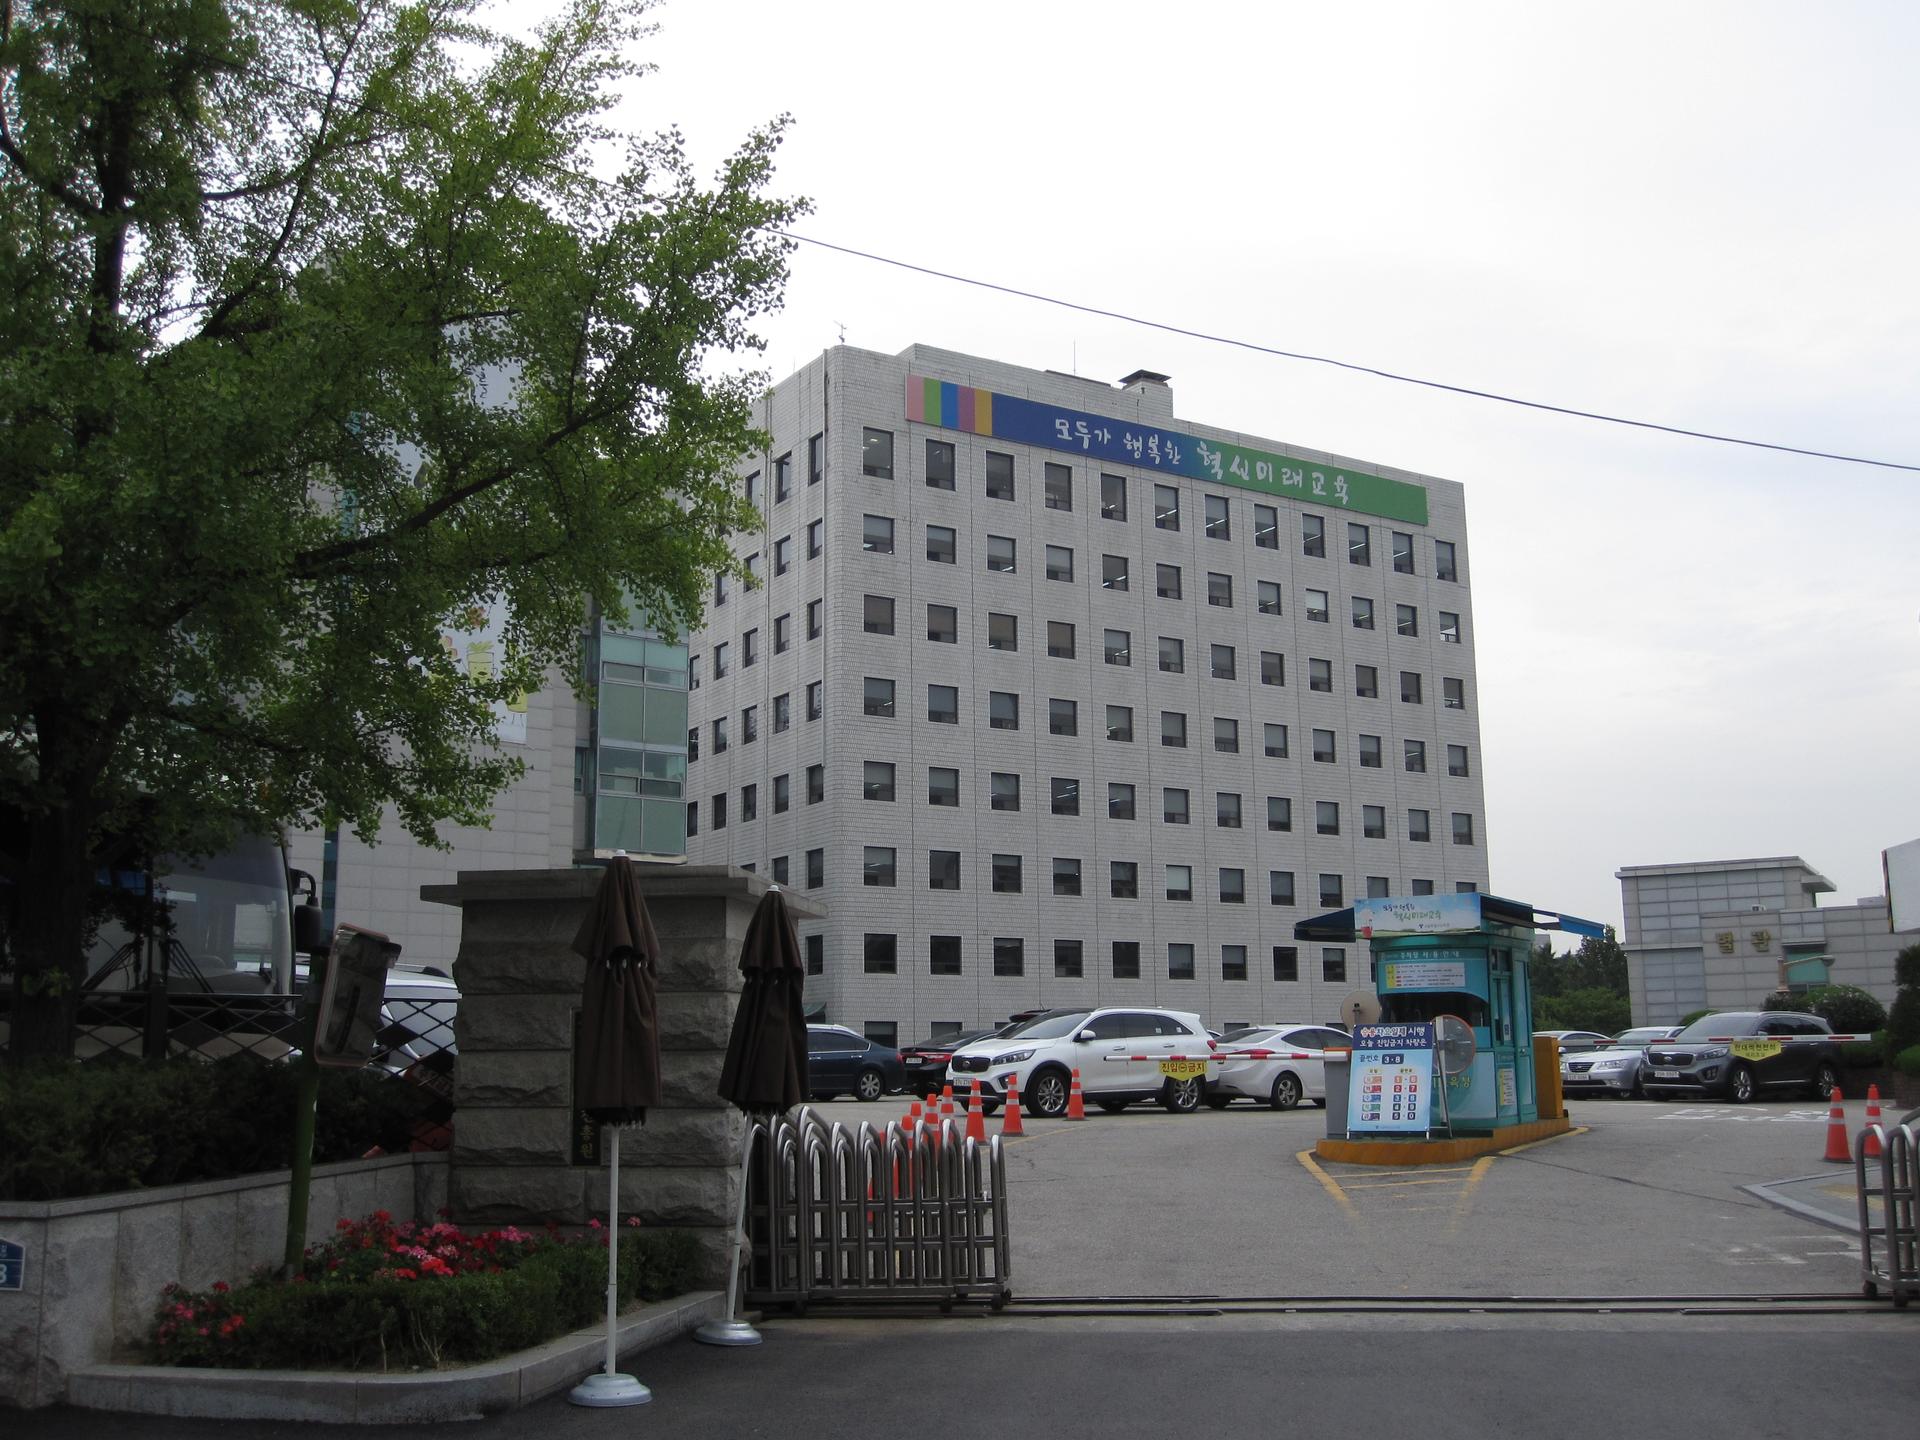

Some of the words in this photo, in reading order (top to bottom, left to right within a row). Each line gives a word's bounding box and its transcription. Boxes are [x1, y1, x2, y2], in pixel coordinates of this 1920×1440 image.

[1055, 418, 1112, 449] 모두가
[1123, 432, 1181, 465] 행복한
[1197, 440, 1349, 505] 혁신미래교육
[1408, 1026, 1426, 1037] 시행
[1360, 1040, 1374, 1048] 오늘
[1377, 1038, 1404, 1048] 진입금지
[1406, 1038, 1427, 1047] 차량은
[1162, 1063, 1178, 1073] 진입
[1188, 1063, 1205, 1073] 금지
